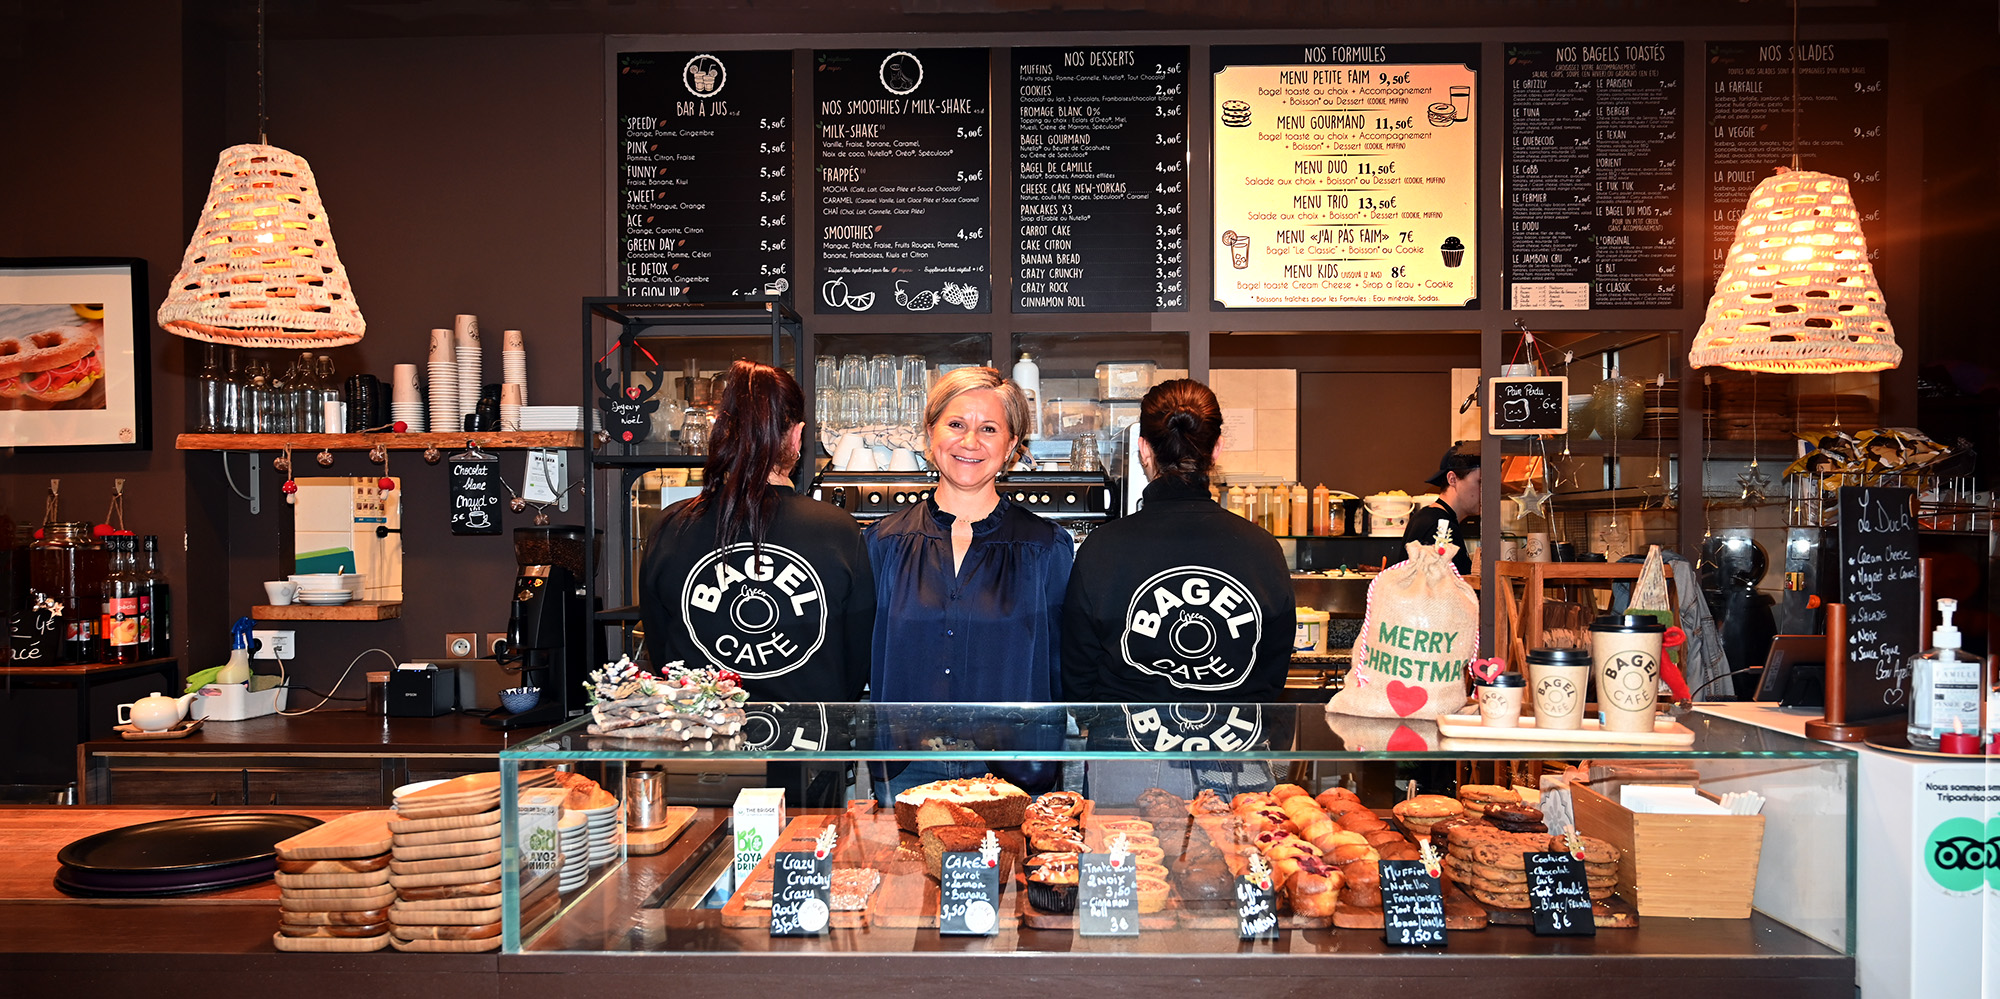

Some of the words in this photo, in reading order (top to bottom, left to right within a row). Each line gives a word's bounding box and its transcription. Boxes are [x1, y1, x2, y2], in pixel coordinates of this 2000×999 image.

[1064, 53, 1085, 67] NOS
[1090, 51, 1135, 66] DESSERTS
[1304, 47, 1326, 63] NOS
[1332, 46, 1386, 63] FORMULES
[1556, 47, 1577, 62] NOS
[1583, 46, 1619, 62] BAGELS
[1626, 43, 1665, 61] TOASTÉS
[1759, 46, 1782, 62] NOS
[1020, 65, 1053, 75] MUFFINS
[1280, 71, 1308, 85] MENU
[1313, 71, 1342, 85] PETITE
[1348, 70, 1370, 84] FAIM
[1596, 79, 1603, 88] LE
[1606, 79, 1632, 88] PARISIEN
[1020, 86, 1052, 96] COOKIES
[1258, 87, 1282, 96] Bagel
[1285, 87, 1310, 95] toasté
[1328, 87, 1348, 95] choix
[1359, 86, 1432, 96] Accompagnement
[1513, 80, 1520, 89] LE
[1523, 80, 1547, 89] GRIZZLY
[1715, 82, 1724, 93] LA
[1729, 81, 1763, 93] FARFALLE
[677, 101, 694, 117] BAR
[699, 100, 705, 117] À
[710, 101, 727, 116] JUS
[822, 100, 842, 115] NOS
[847, 99, 900, 115] SMOOTHIES
[912, 99, 971, 114] MILK-SHAKE
[1020, 107, 1054, 117] FROMAGE
[1058, 106, 1082, 116] BLANC
[1087, 106, 1100, 116] 0%
[627, 117, 657, 130] SPEEDY
[1277, 116, 1305, 129] MENU
[1310, 115, 1365, 129] GOURMAND
[822, 124, 878, 139] MILK-SHAKE
[1715, 126, 1724, 138] LA
[1728, 126, 1755, 138] VEGGIE
[1020, 135, 1043, 145] BAGEL
[1048, 134, 1090, 145] GOURMAND
[1513, 137, 1520, 146] LE
[1523, 136, 1554, 146] QUEBECOIS
[627, 141, 648, 154] PINK
[627, 166, 657, 178] FUNNY
[822, 165, 859, 182] FRAPPÉS
[1294, 161, 1323, 174] MENU
[1328, 161, 1348, 174] DUO
[1245, 177, 1275, 186] Salade
[1295, 177, 1315, 185] choix
[1020, 183, 1047, 194] CHEESE
[1051, 183, 1071, 194] CAKE
[1075, 183, 1127, 194] NEW-YORKAIS
[627, 190, 654, 203] SWEET
[1596, 207, 1603, 216] LE
[1606, 207, 1623, 216] BAGEL
[1627, 207, 1635, 216] DU
[1637, 206, 1652, 215] MOIS
[627, 214, 642, 227] ACE
[824, 225, 873, 240] SMOOTHIES
[1020, 226, 1047, 236] CARROT
[1051, 226, 1071, 236] CAKE
[1277, 230, 1305, 243] MENU
[1338, 230, 1354, 243] PAS
[1399, 231, 1414, 243] 7€
[627, 239, 655, 251] GREEN
[659, 239, 675, 251] DAY
[1021, 254, 1053, 265] BANANA
[1057, 254, 1080, 264] BREAD
[627, 263, 636, 275] LE
[641, 262, 668, 275] DETOX
[1596, 283, 1603, 292] LE
[1606, 283, 1631, 292] CLASSIC
[1021, 297, 1064, 307] CINNAMON
[1068, 297, 1086, 307] ROLL
[454, 465, 488, 476] Chocolat
[462, 477, 486, 490] blanc
[456, 495, 487, 509] Chaud
[690, 554, 819, 617] BAGEL
[1131, 578, 1255, 639] BAGEL
[1378, 621, 1459, 653] MERRY
[715, 632, 798, 666] CAFÉ
[1152, 656, 1234, 680] CAFÉ
[1605, 654, 1657, 682] BAGEL
[1538, 679, 1575, 698] BAGEL
[1614, 689, 1650, 704] CAFÉ
[1926, 783, 1948, 791] Nous
[736, 853, 762, 862] SOYA
[783, 854, 815, 874] Crazy
